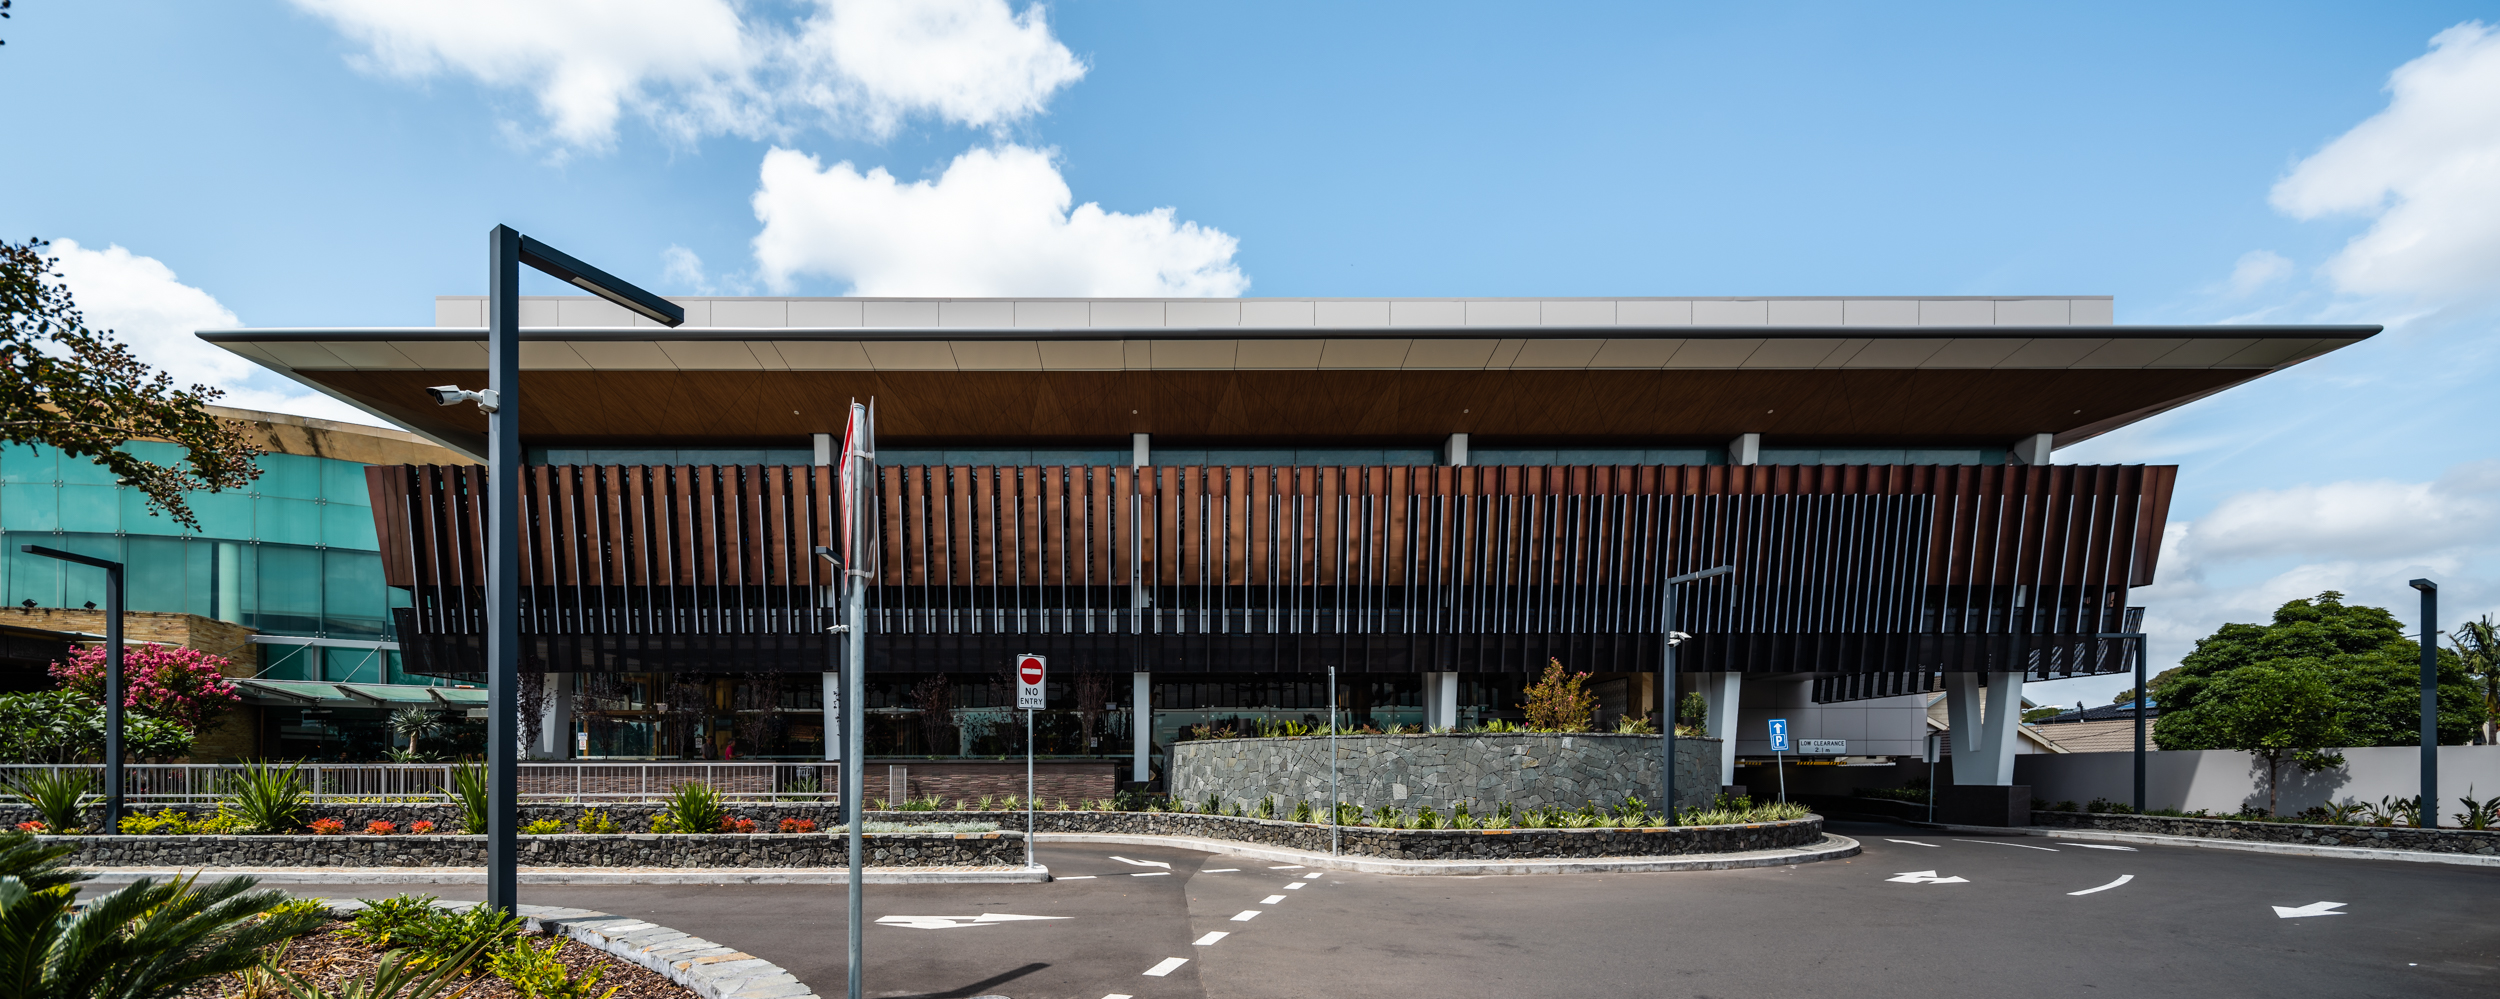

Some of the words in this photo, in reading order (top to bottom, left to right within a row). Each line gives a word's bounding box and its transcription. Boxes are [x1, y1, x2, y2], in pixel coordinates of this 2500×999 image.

[1025, 687, 1038, 696] NO
[1020, 697, 1043, 705] ENTRY
[1776, 736, 1782, 746] P
